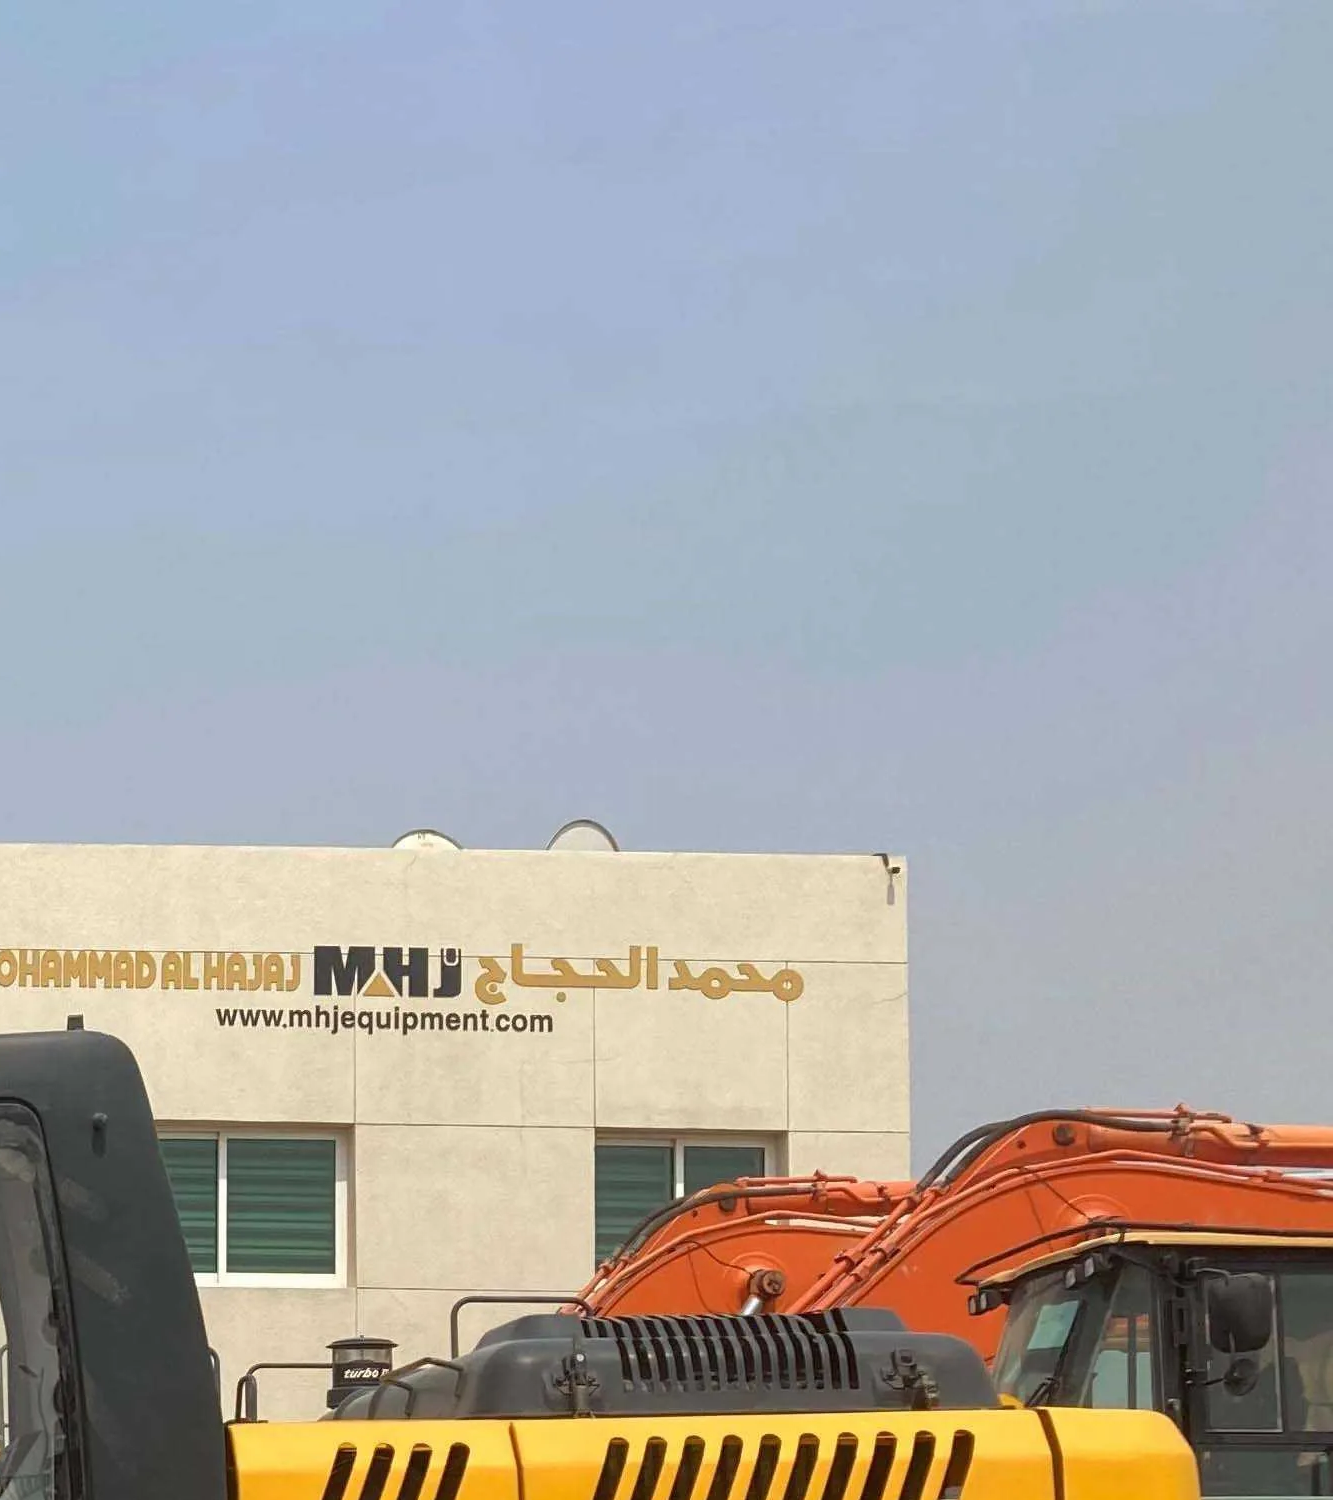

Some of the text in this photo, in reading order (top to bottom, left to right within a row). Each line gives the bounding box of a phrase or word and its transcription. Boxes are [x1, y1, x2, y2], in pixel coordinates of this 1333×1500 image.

[475, 943, 805, 1005] محمد الحجاج
[215, 1005, 554, 1036] www.mhjequipment.com
[343, 1367, 379, 1378] turbo
